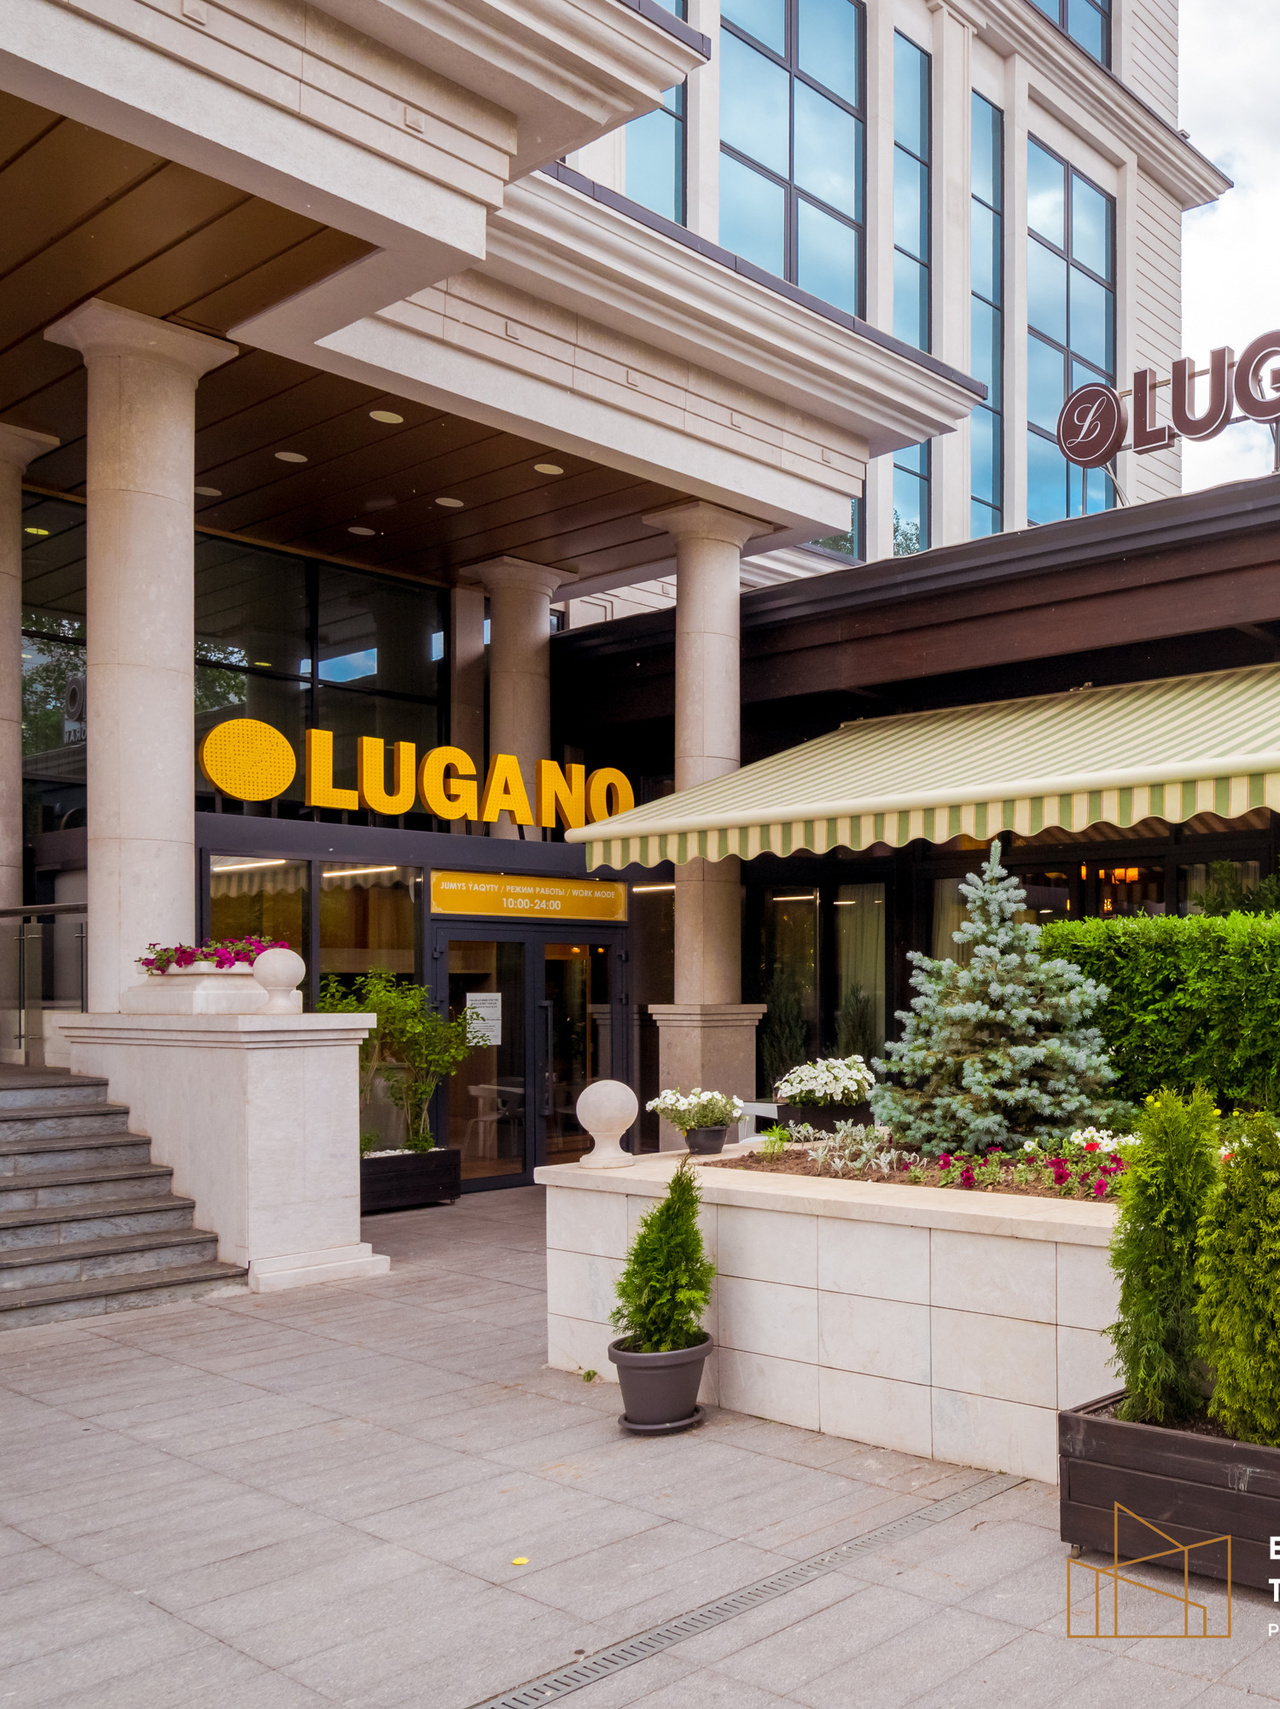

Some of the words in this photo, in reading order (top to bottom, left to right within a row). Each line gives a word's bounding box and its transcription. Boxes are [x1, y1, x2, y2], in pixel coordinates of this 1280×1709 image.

[305, 728, 635, 829] LUGANO
[440, 881, 466, 890] JUMYS
[468, 881, 499, 893] ÝAQYTY
[506, 885, 534, 894] РЕЖИМ
[536, 887, 565, 896] РАБОТЫ
[572, 889, 593, 898] WORK
[594, 890, 615, 899] MODE
[502, 897, 561, 911] 10:00-24:00
